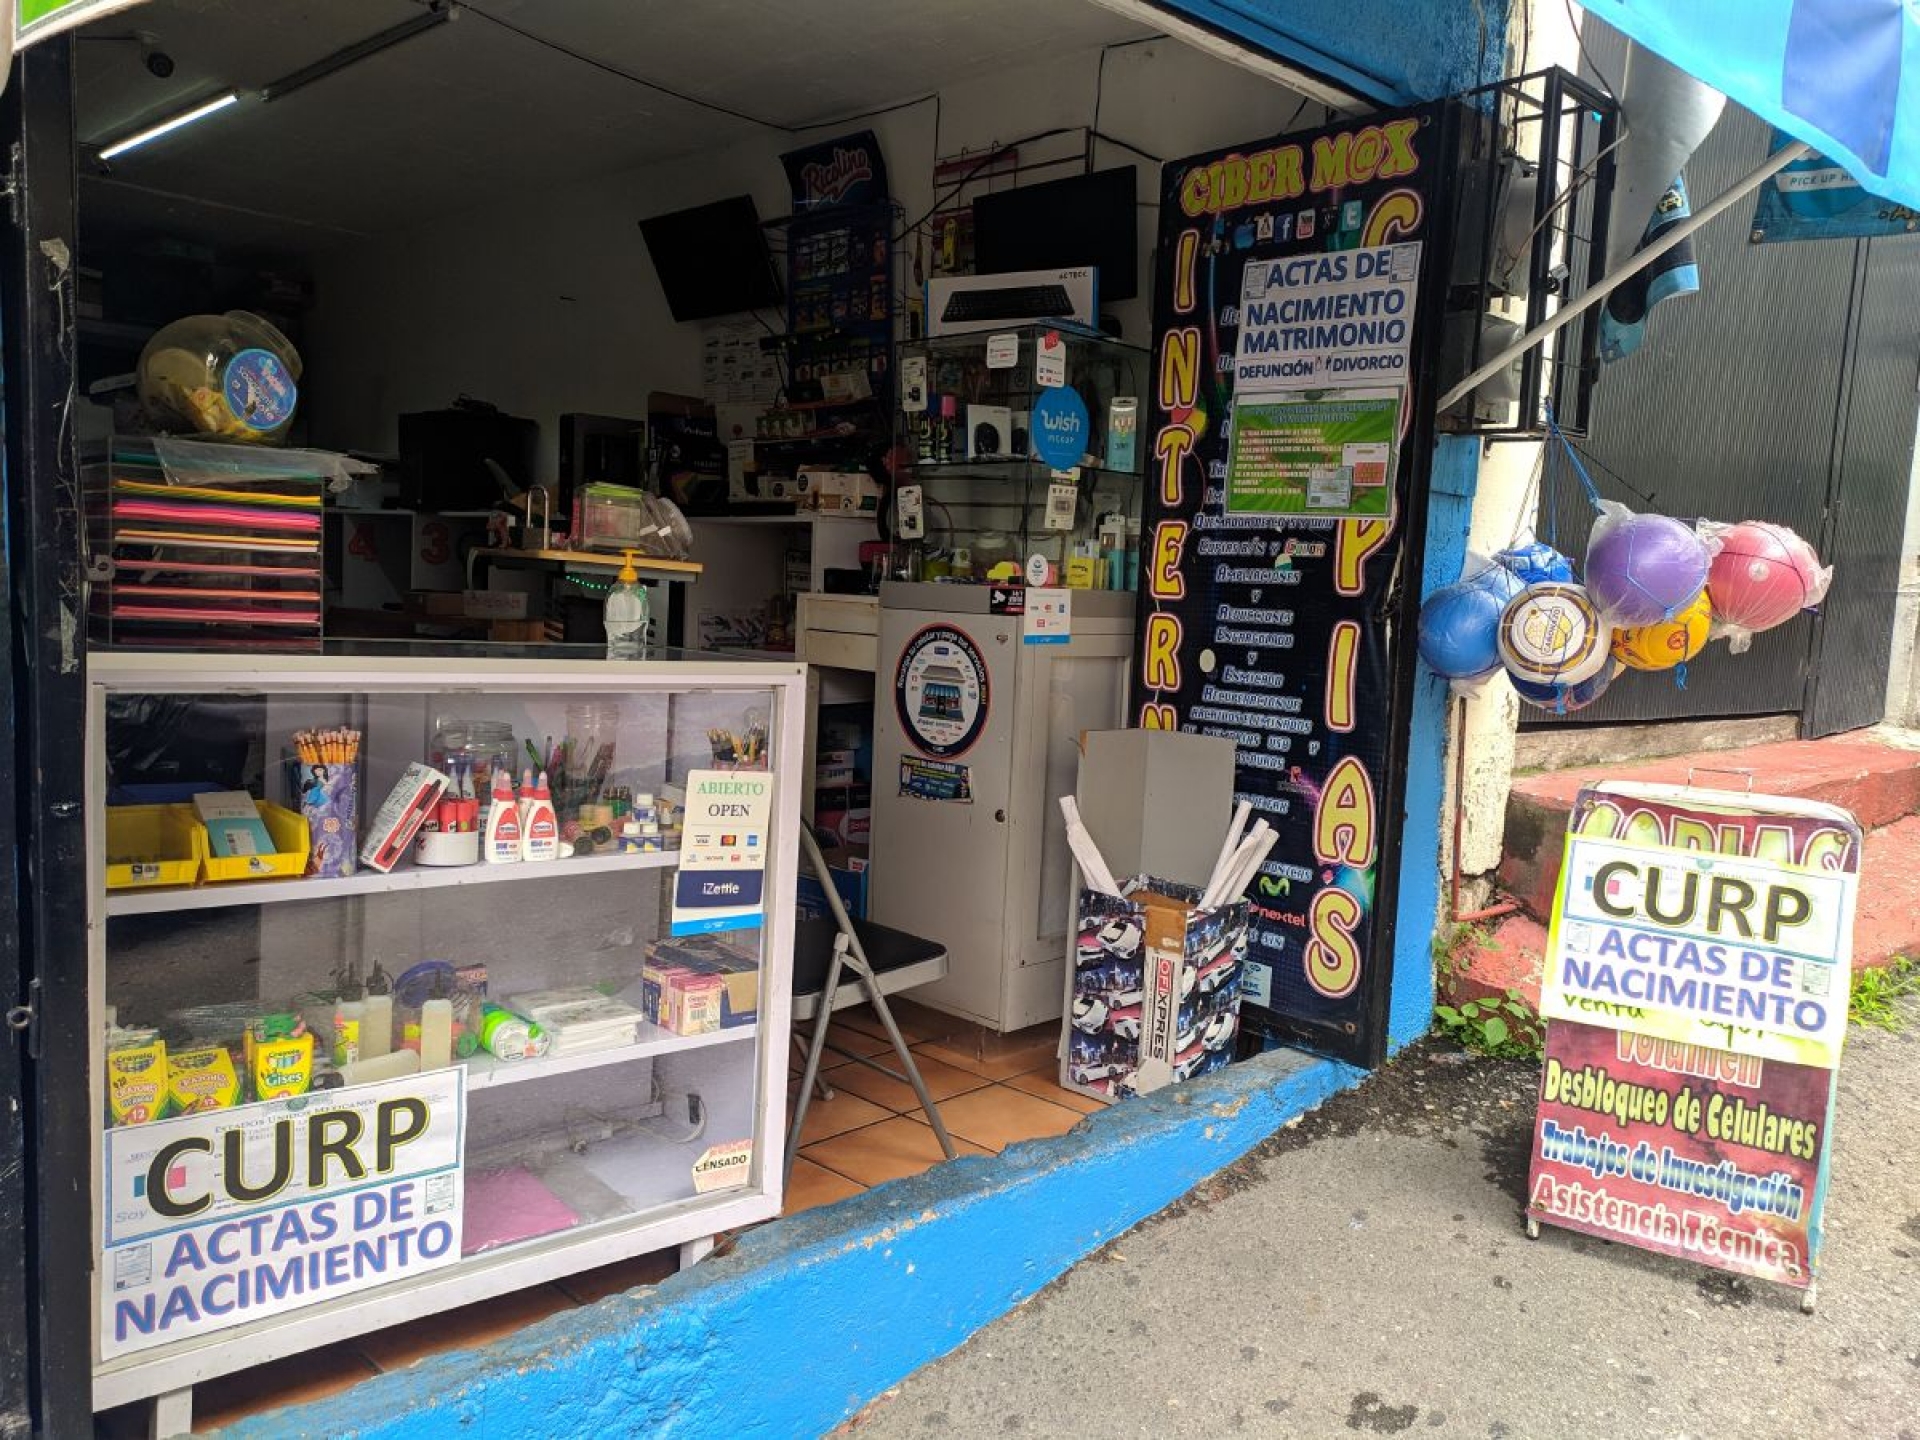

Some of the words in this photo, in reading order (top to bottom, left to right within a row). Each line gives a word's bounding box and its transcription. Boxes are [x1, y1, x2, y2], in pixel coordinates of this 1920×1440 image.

[803, 147, 871, 196] Ricolino
[1181, 146, 1304, 217] CIBER
[1310, 118, 1419, 190] M@X
[1790, 177, 1817, 186] PICK
[1820, 174, 1836, 183] UP
[1267, 255, 1348, 288] ACTAS
[1355, 250, 1391, 280] DE
[1247, 289, 1405, 327] NACIMIENTO
[1243, 319, 1405, 354] MATRIMONIO
[1239, 359, 1313, 379] DEFUNCIÓN
[1332, 354, 1404, 373] DIVORCIO
[1041, 409, 1081, 433] wish
[421, 522, 450, 564] 3
[696, 781, 764, 796] ABIERTO
[708, 804, 752, 818] OPEN
[702, 882, 741, 896] iZettle
[1592, 860, 1813, 944] CURP
[1260, 909, 1306, 928] nextel
[1598, 928, 1727, 977] ACTAS
[1740, 952, 1795, 989] DE
[1562, 957, 1827, 1033] NACIMIENTO
[116, 1052, 153, 1063] Crayola
[265, 1071, 303, 1087] Gises
[132, 1107, 146, 1121] 12
[1544, 1059, 1668, 1128] Desbloqueo
[1673, 1087, 1701, 1134] de
[1707, 1094, 1818, 1160] Celulares
[146, 1097, 431, 1218] CURP
[695, 1154, 747, 1172] CENSADO
[1541, 1120, 1629, 1178] Trabajos
[1629, 1141, 1657, 1184] de
[1659, 1147, 1803, 1220] Investigación
[164, 1202, 338, 1279] ACTAS
[353, 1183, 415, 1232] DE
[1532, 1174, 1681, 1245] Asistencia
[1681, 1210, 1801, 1269] Técnica
[114, 1220, 454, 1342] NACIMIENTO
